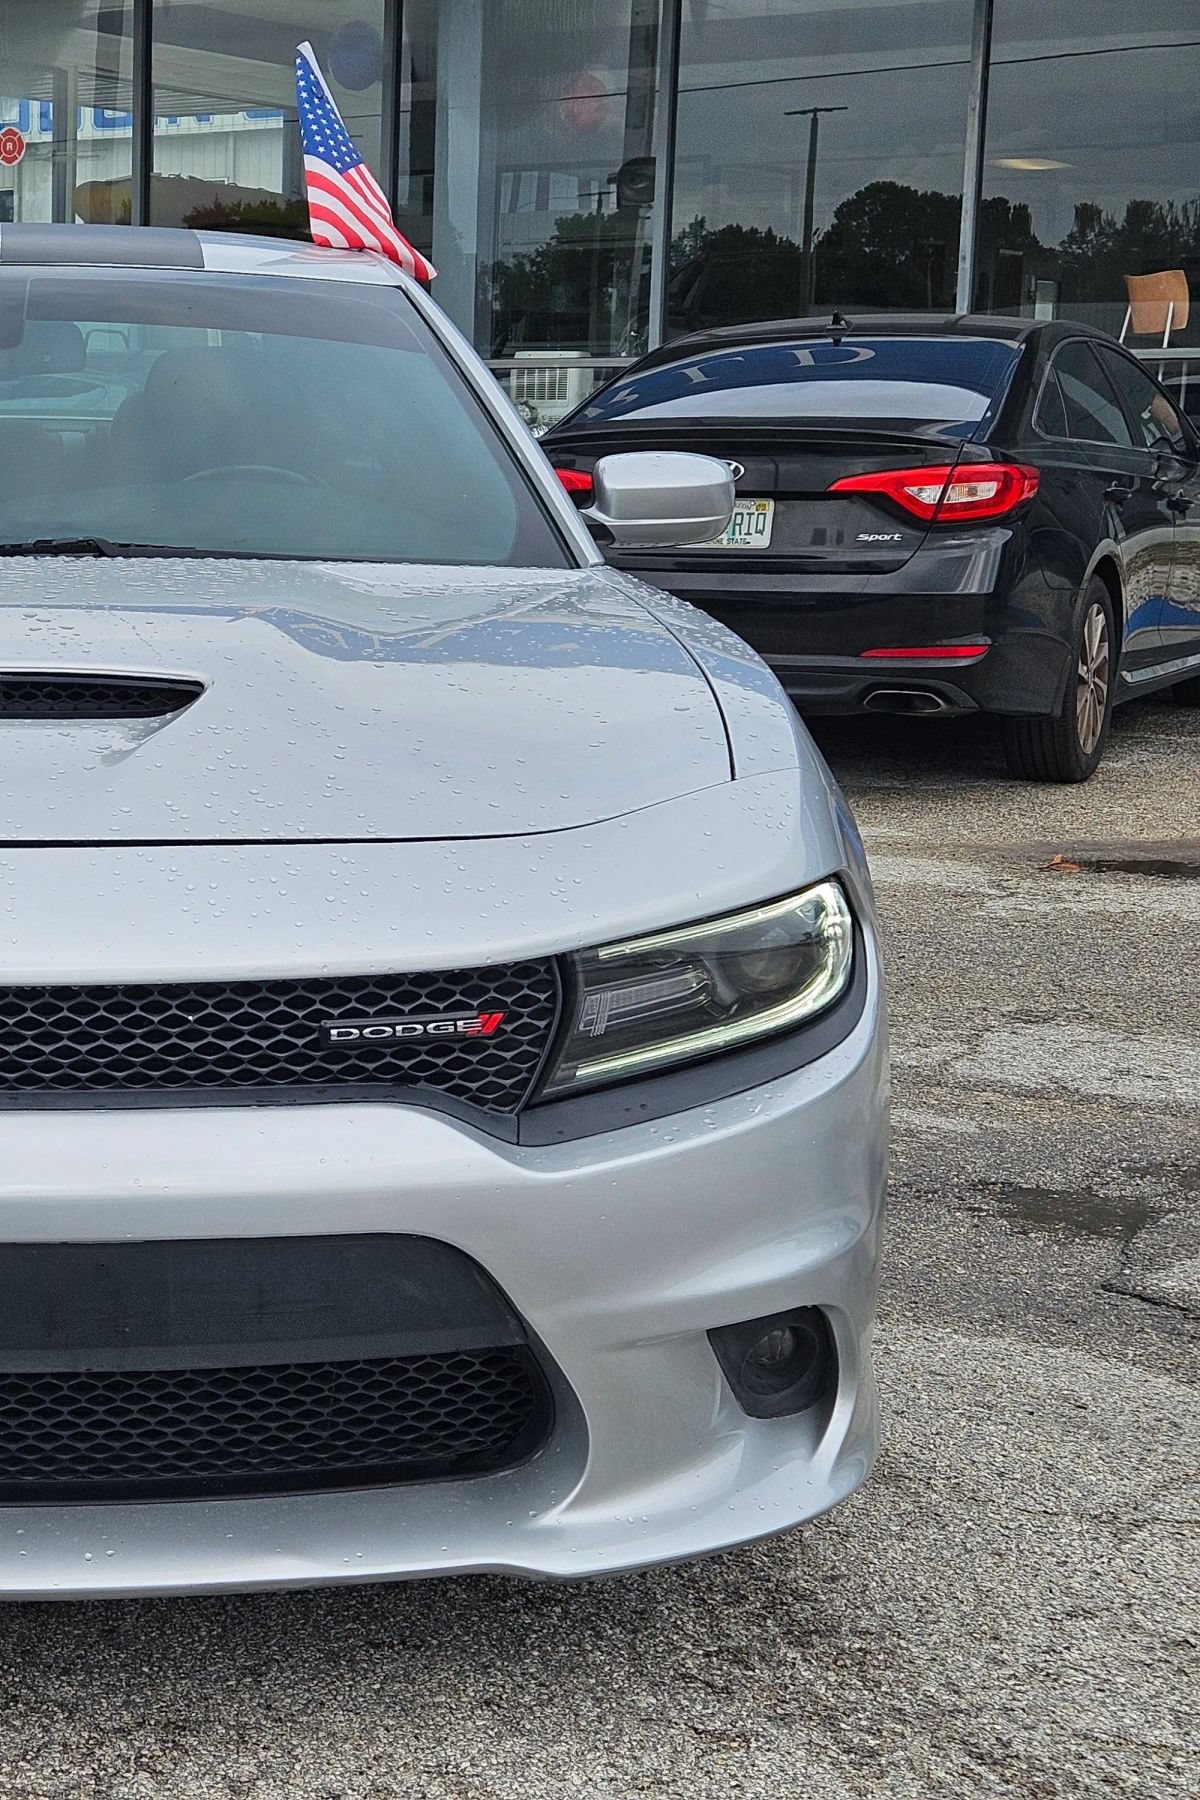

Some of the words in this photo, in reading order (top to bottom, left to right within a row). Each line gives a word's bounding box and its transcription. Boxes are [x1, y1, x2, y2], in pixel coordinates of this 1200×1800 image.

[6, 142, 13, 151] R
[855, 533, 903, 542] Sport
[329, 1018, 483, 1041] DODGE
